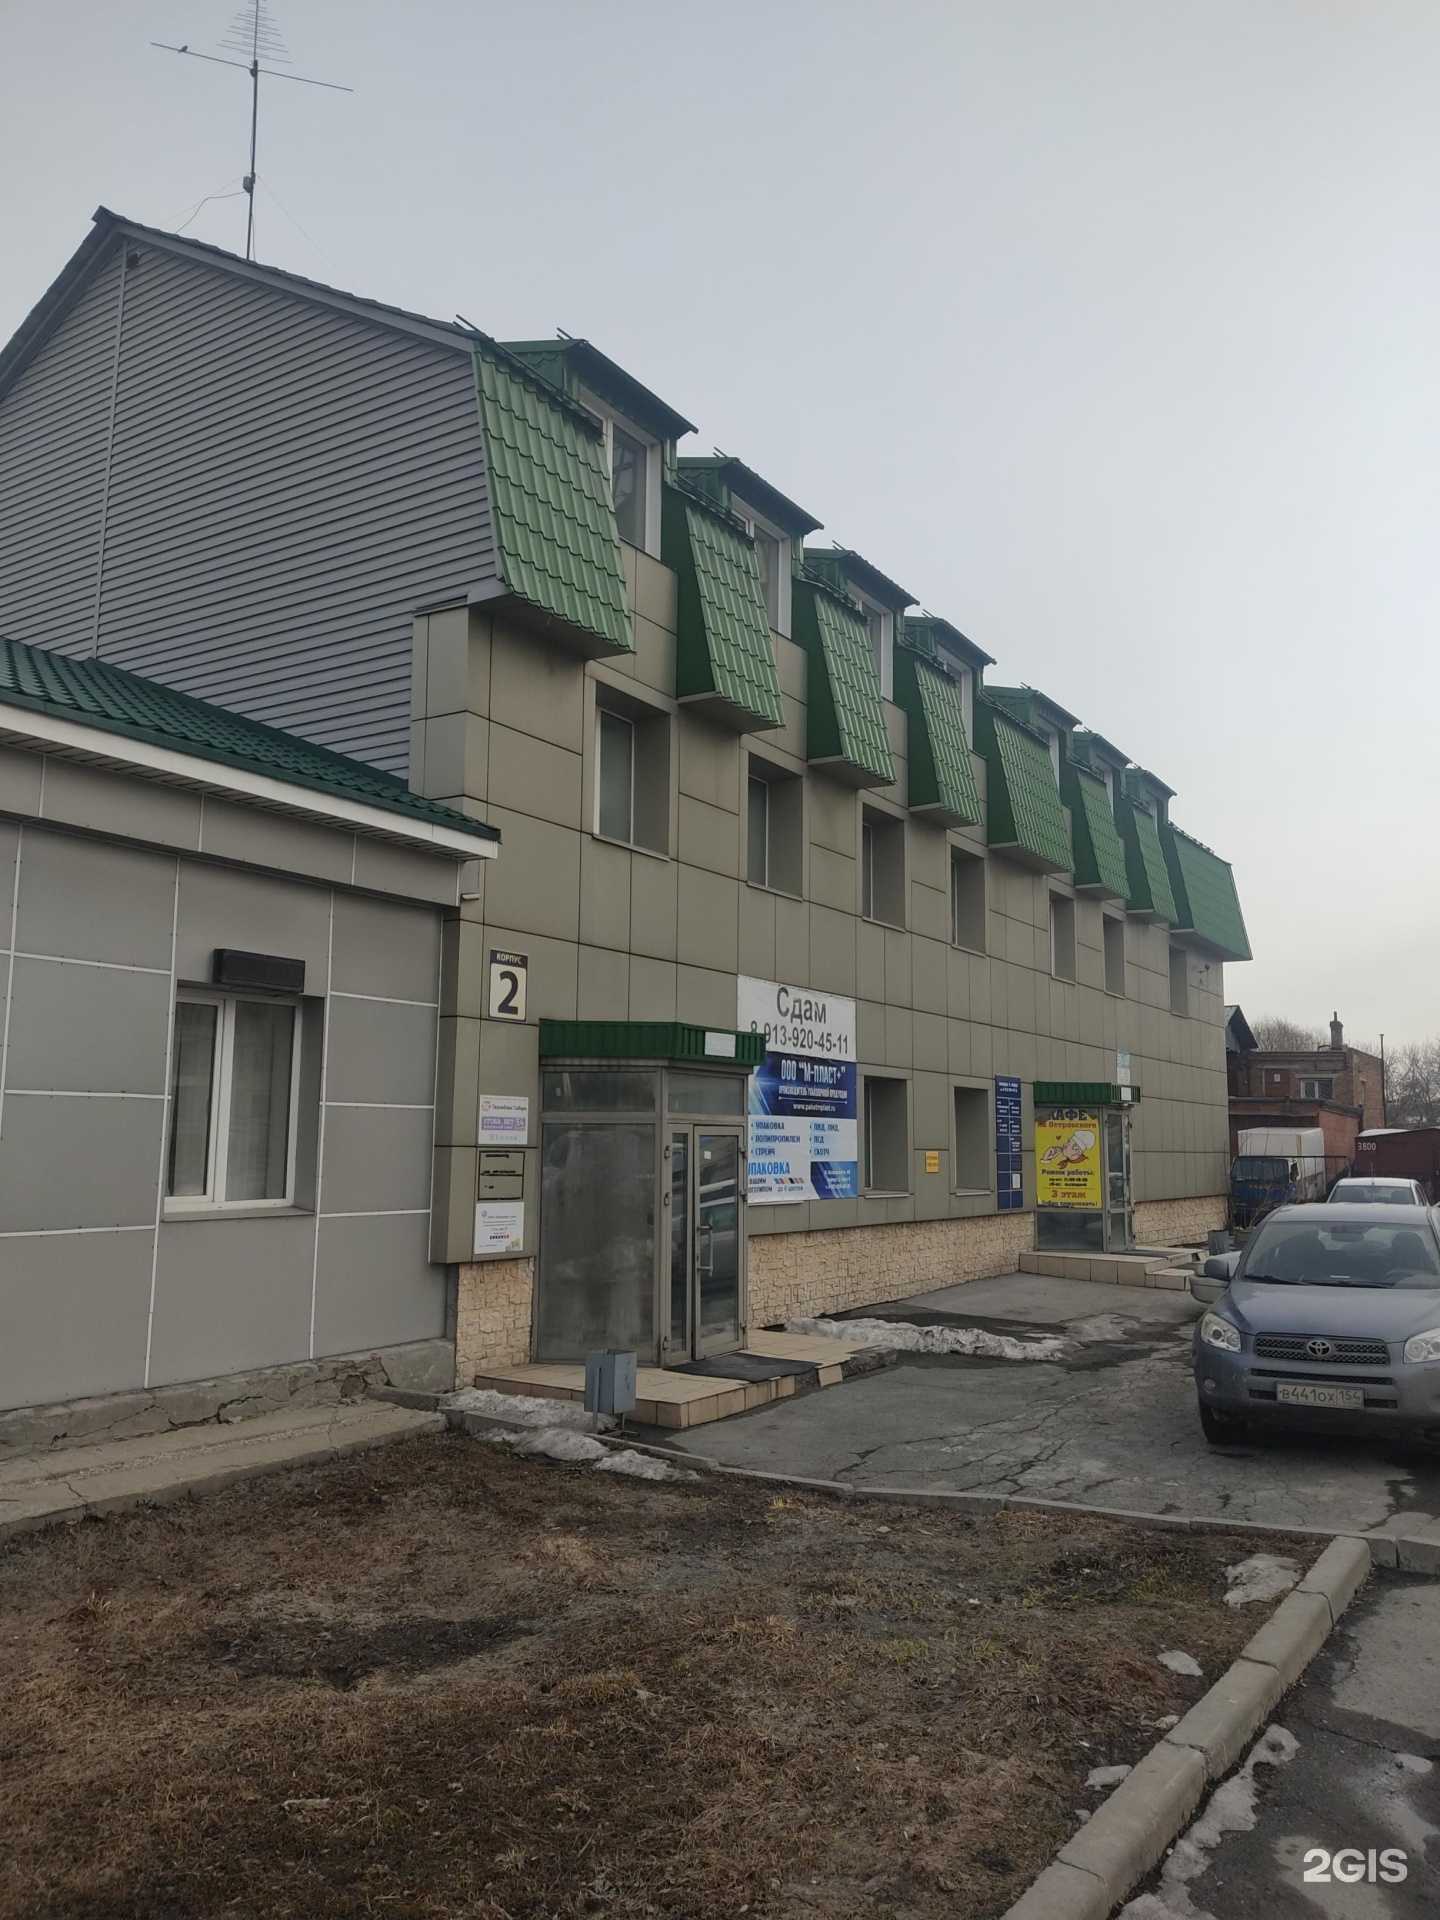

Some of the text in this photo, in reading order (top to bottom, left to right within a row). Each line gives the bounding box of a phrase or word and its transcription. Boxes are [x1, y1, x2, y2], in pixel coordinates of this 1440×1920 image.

[496, 952, 522, 964] КОРПУС
[498, 971, 518, 1015] 2
[777, 987, 826, 1024] Сдам
[781, 1060, 797, 1080] ООО
[1051, 1190, 1087, 1199] 3 этаж
